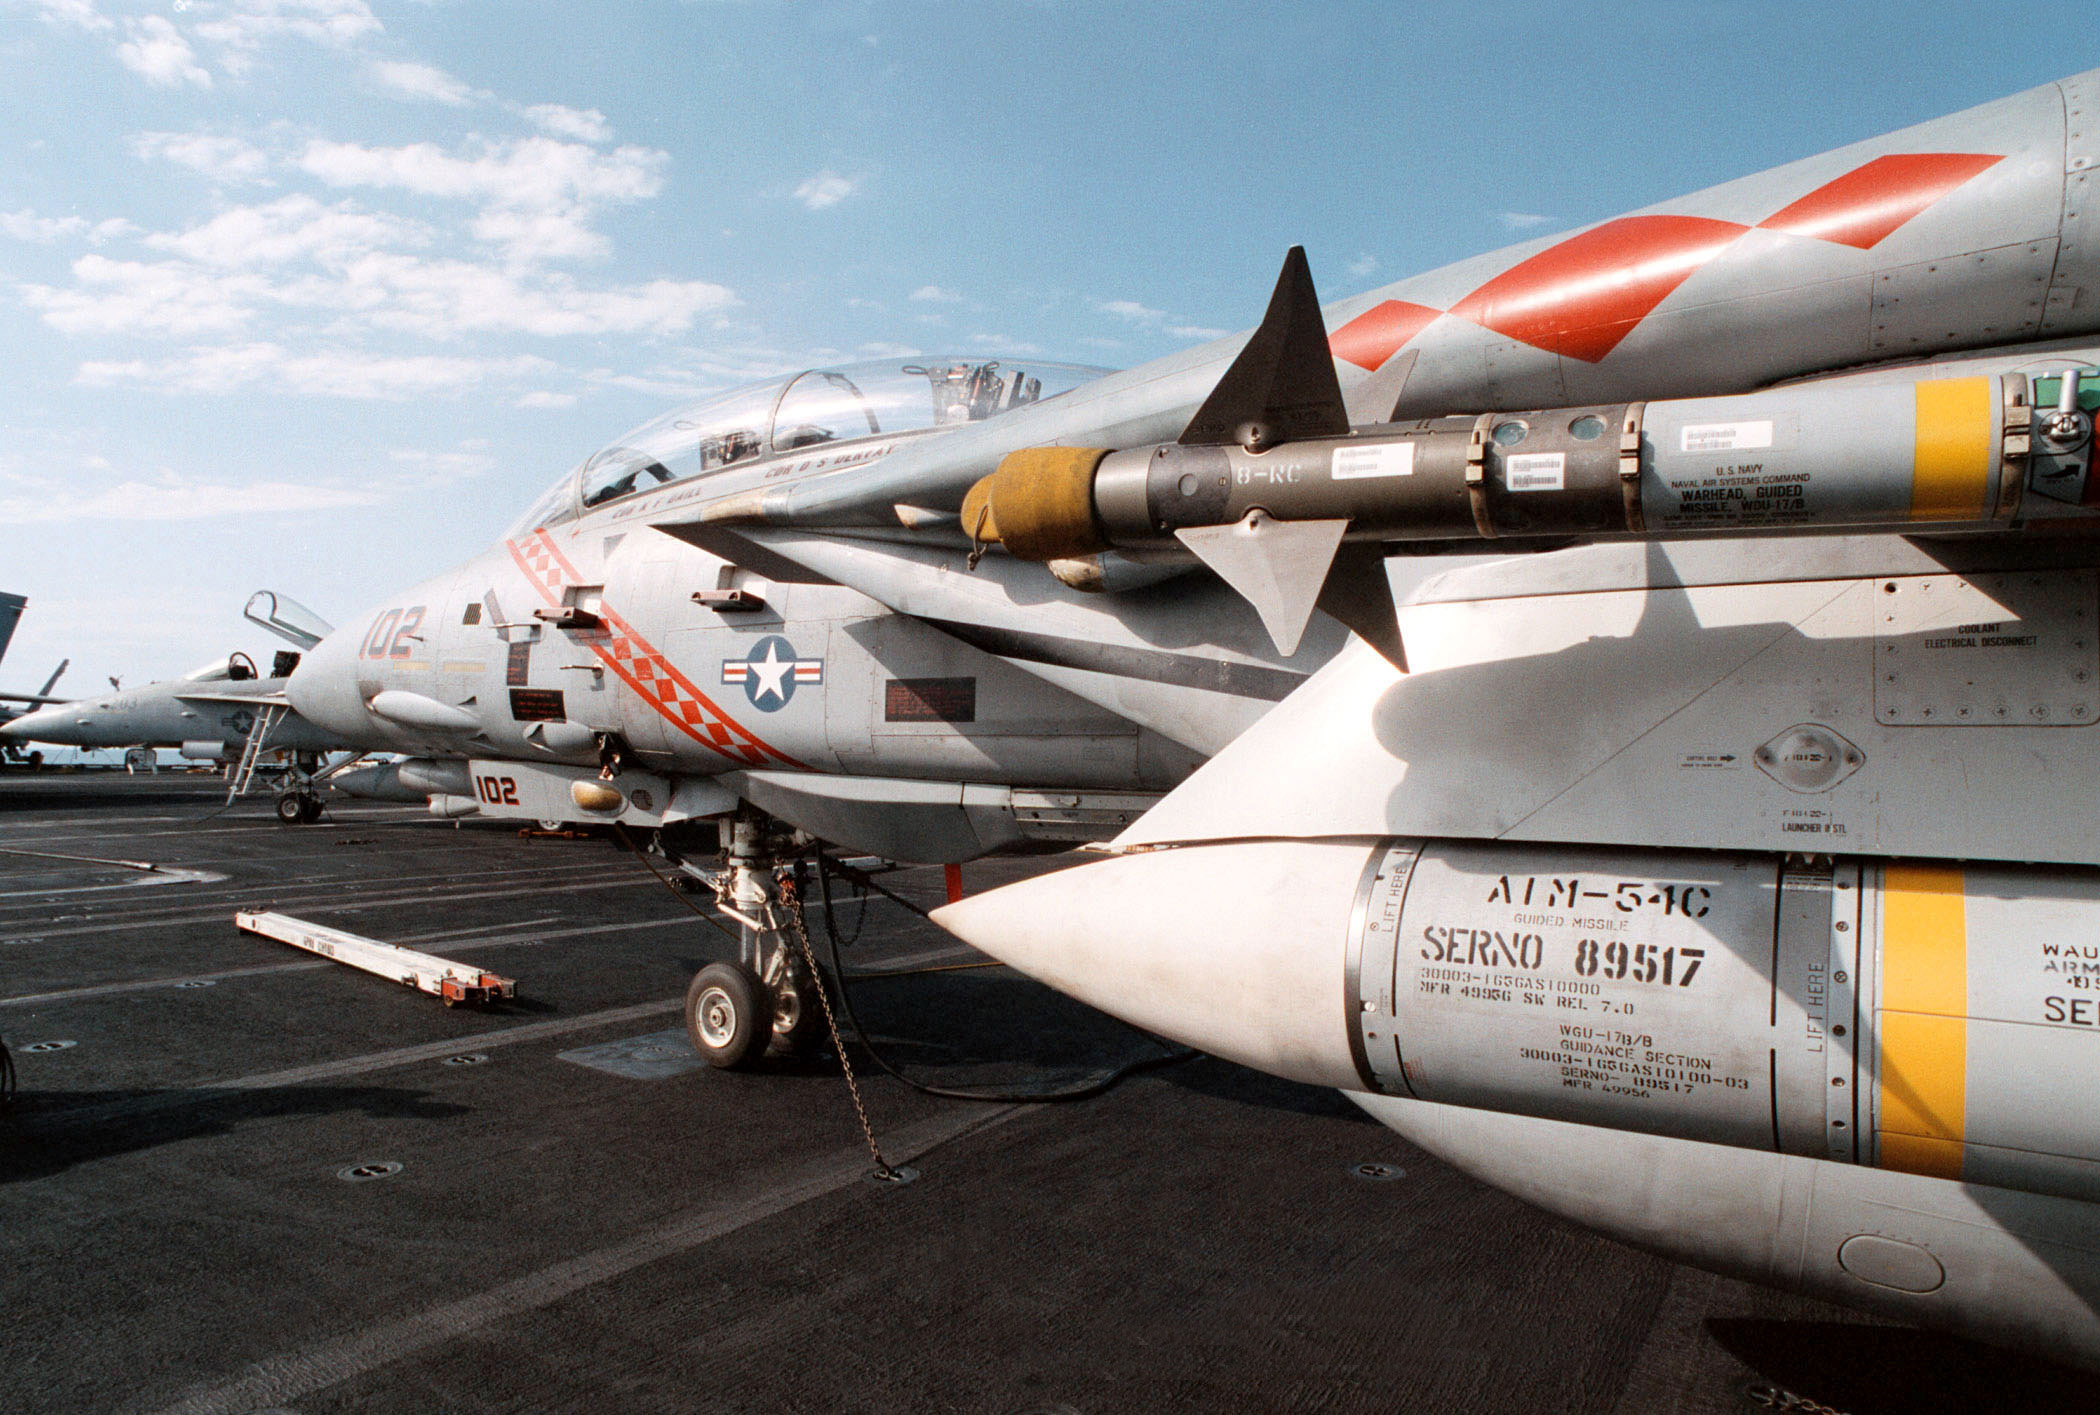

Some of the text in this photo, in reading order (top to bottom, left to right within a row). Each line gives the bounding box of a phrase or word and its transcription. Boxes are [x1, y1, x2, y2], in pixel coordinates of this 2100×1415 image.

[1671, 472, 1811, 489] NAVAL AIR SYSTEMS COMMAND
[1738, 463, 1763, 474] NAVY
[1756, 484, 1803, 499] GUIDED
[358, 604, 428, 661] 102
[1958, 623, 2001, 634] COOLANT
[1924, 635, 2039, 649] ELECTRICAL DISCONNECT
[475, 774, 520, 806] 102
[1782, 822, 1822, 833] LAUNCHER
[1382, 865, 1410, 933] LIFT HERE
[1487, 875, 1712, 919] AIM-54C
[1513, 912, 1630, 932] GUIDED MISSILE
[1421, 925, 1706, 987] SERNO 89517
[1420, 980, 1450, 996] MFR
[1460, 986, 1512, 1002] 49956
[1557, 995, 1589, 1012] REL
[1601, 1000, 1635, 1016] 7.0
[1806, 962, 1825, 1053] LIFT HERE
[2044, 995, 2100, 1027] SE
[1559, 1039, 1712, 1070] GUIDANCE SECTION
[1562, 1078, 1651, 1099] MFR 49956
[1633, 1076, 1695, 1095] 89517
